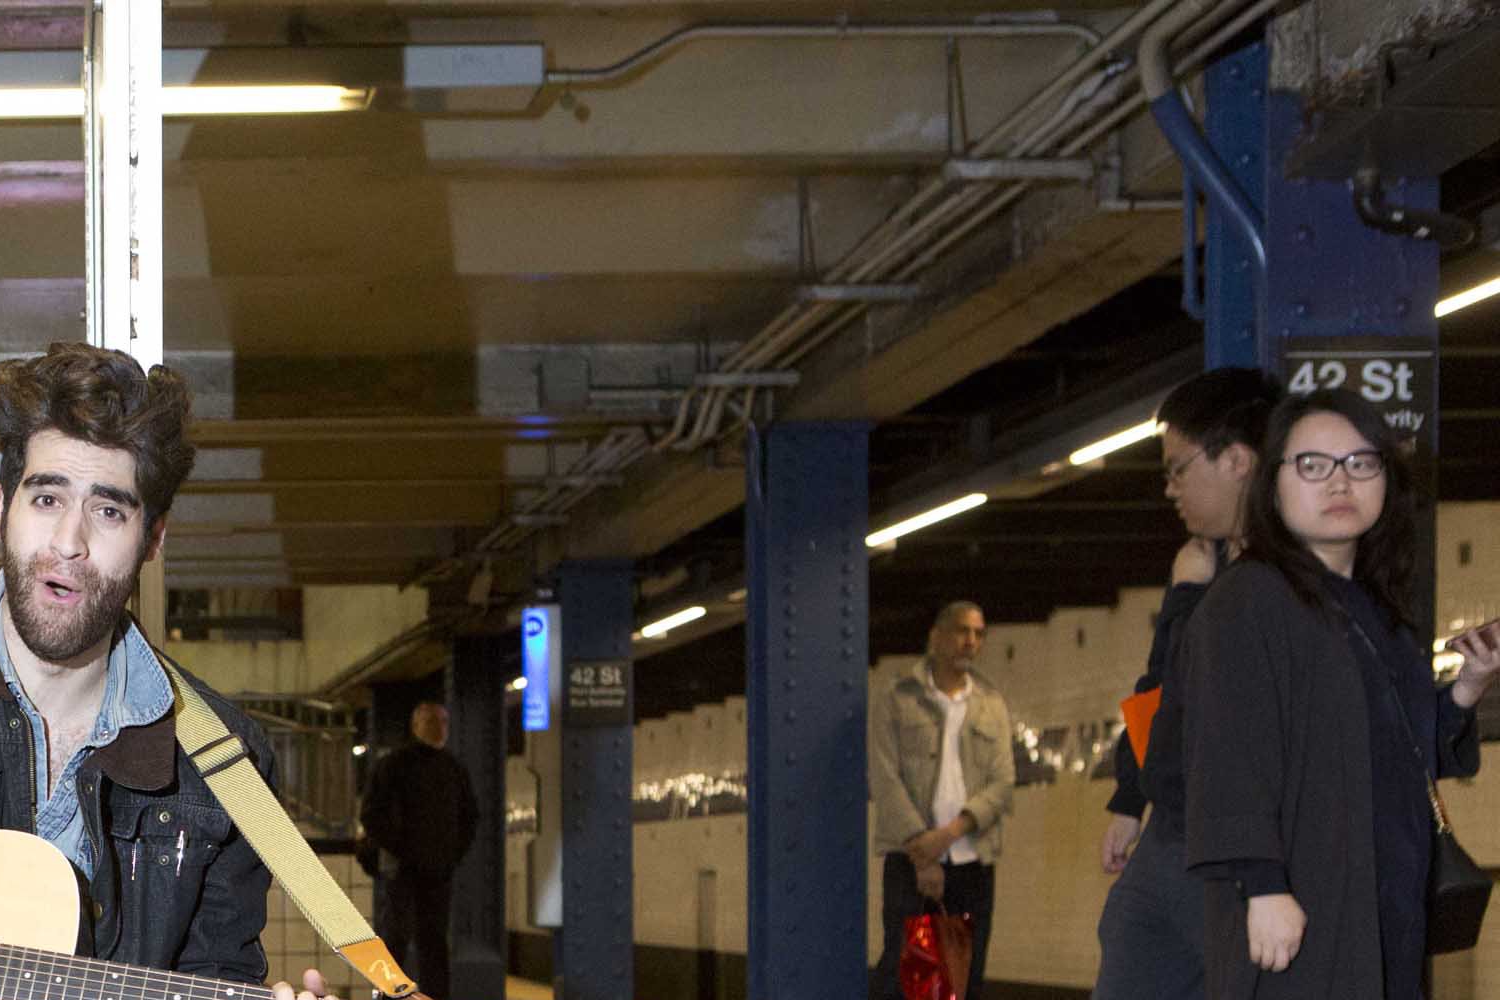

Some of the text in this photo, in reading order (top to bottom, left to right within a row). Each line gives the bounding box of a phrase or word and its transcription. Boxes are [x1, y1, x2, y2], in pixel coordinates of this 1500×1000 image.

[1288, 359, 1414, 402] 42 St
[570, 665, 622, 686] 42 St
